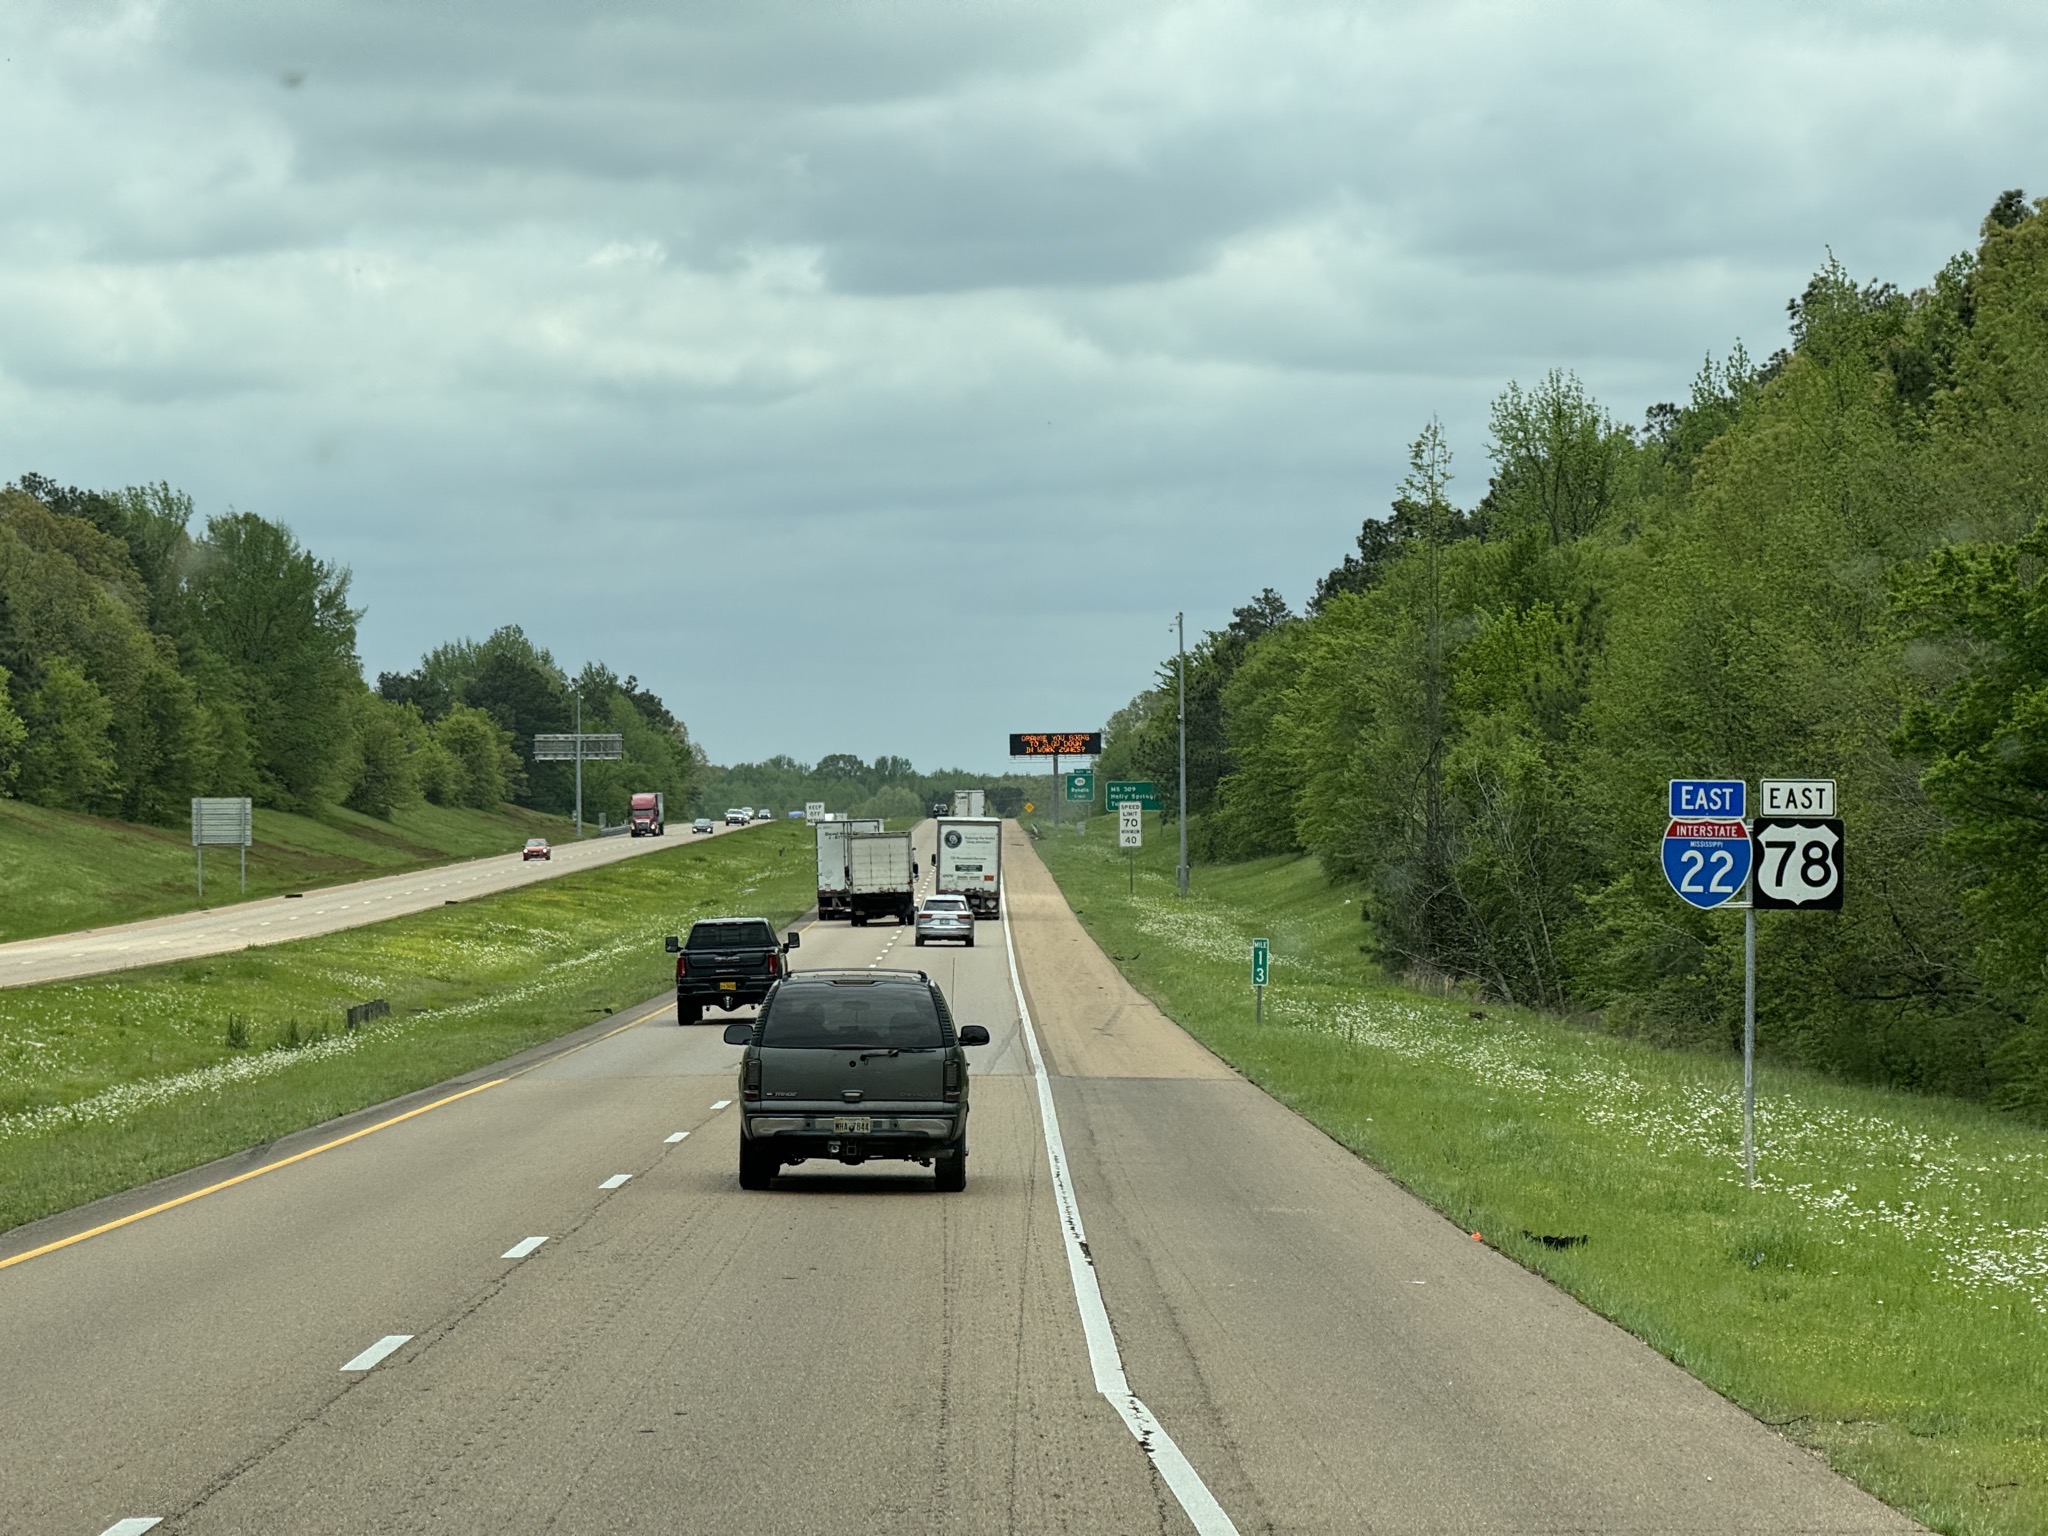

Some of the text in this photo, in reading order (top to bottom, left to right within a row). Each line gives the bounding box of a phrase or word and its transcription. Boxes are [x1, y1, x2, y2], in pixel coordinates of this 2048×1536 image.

[1681, 786, 1733, 810] EAST
[1770, 788, 1826, 809] EAST
[1122, 818, 1138, 828] 70
[1676, 825, 1738, 837] INTERSTATE
[1125, 836, 1137, 844] 40
[1680, 850, 1734, 893] 22
[1765, 840, 1832, 888] 78
[1254, 941, 1267, 949] MILE
